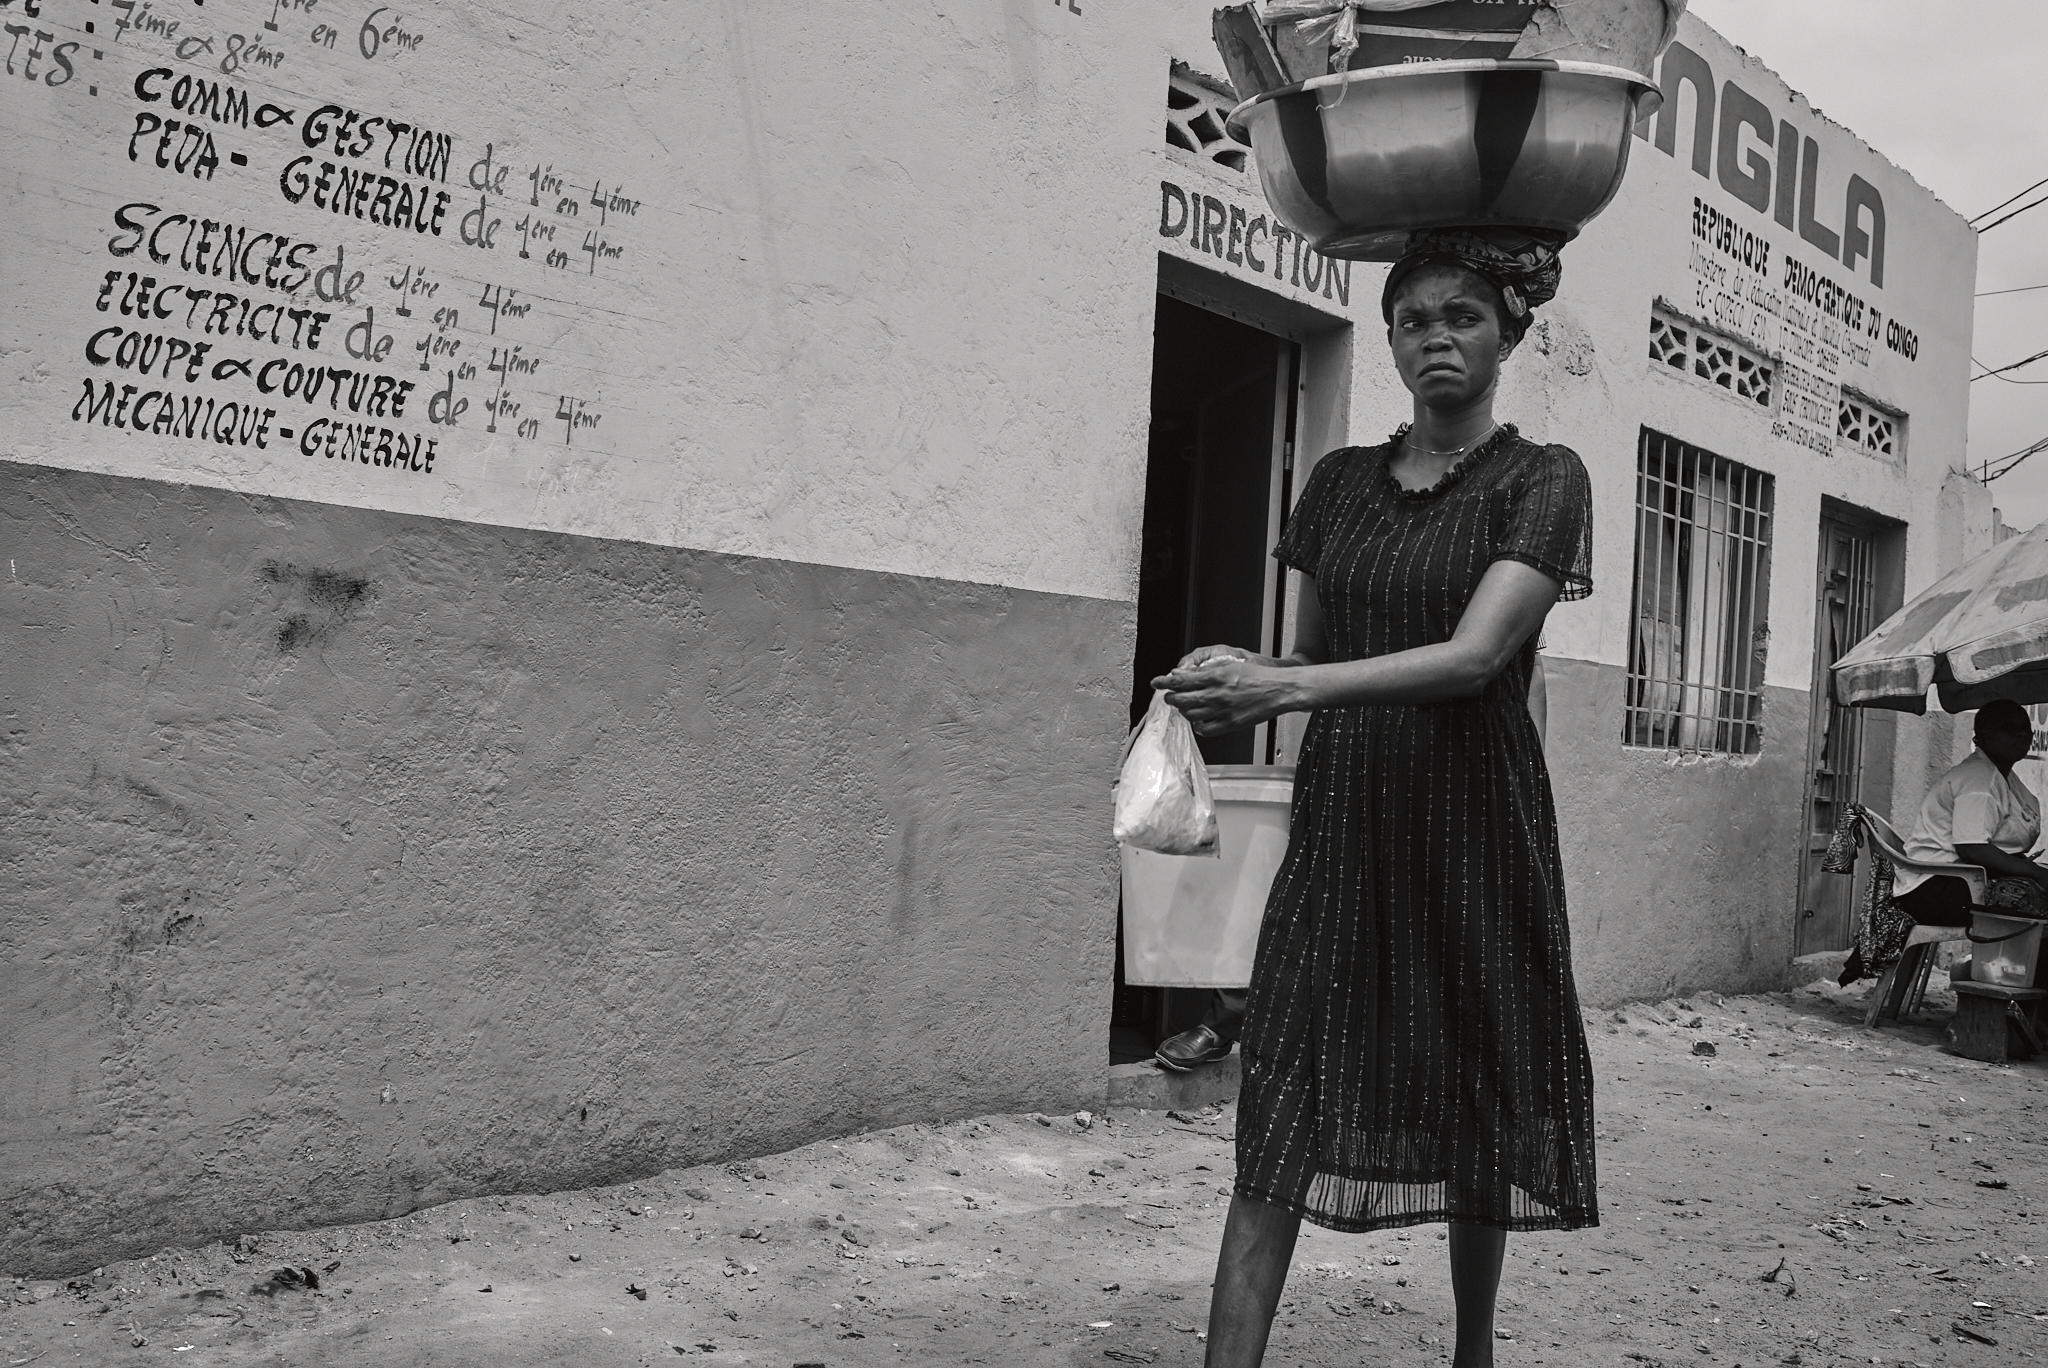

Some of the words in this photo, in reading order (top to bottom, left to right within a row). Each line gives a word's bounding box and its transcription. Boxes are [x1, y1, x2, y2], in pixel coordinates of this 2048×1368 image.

[311, 23, 338, 49] en
[134, 68, 249, 129] COMM
[302, 104, 451, 183] GESTION
[469, 143, 509, 196] de
[556, 197, 579, 216] en
[1633, 40, 1886, 290] NGILA
[108, 202, 317, 293] SCIENCES
[315, 244, 365, 304] de
[434, 304, 458, 328] en
[280, 156, 451, 236] GENERALE
[460, 194, 501, 250] de
[546, 248, 567, 269] en
[1159, 180, 1351, 307] DIRECTION
[96, 270, 331, 350] ELECTRICITE
[344, 306, 394, 363] de
[457, 360, 476, 381] en
[1692, 196, 1770, 277] REPUBLIQUE
[1784, 255, 1864, 331] DEMOCRATIQUE
[1867, 306, 1881, 340] DU
[1886, 318, 1918, 362] CONGO
[85, 326, 212, 383] COUPE
[256, 358, 415, 418] COUTURE
[428, 370, 468, 426] de
[517, 417, 538, 440] en
